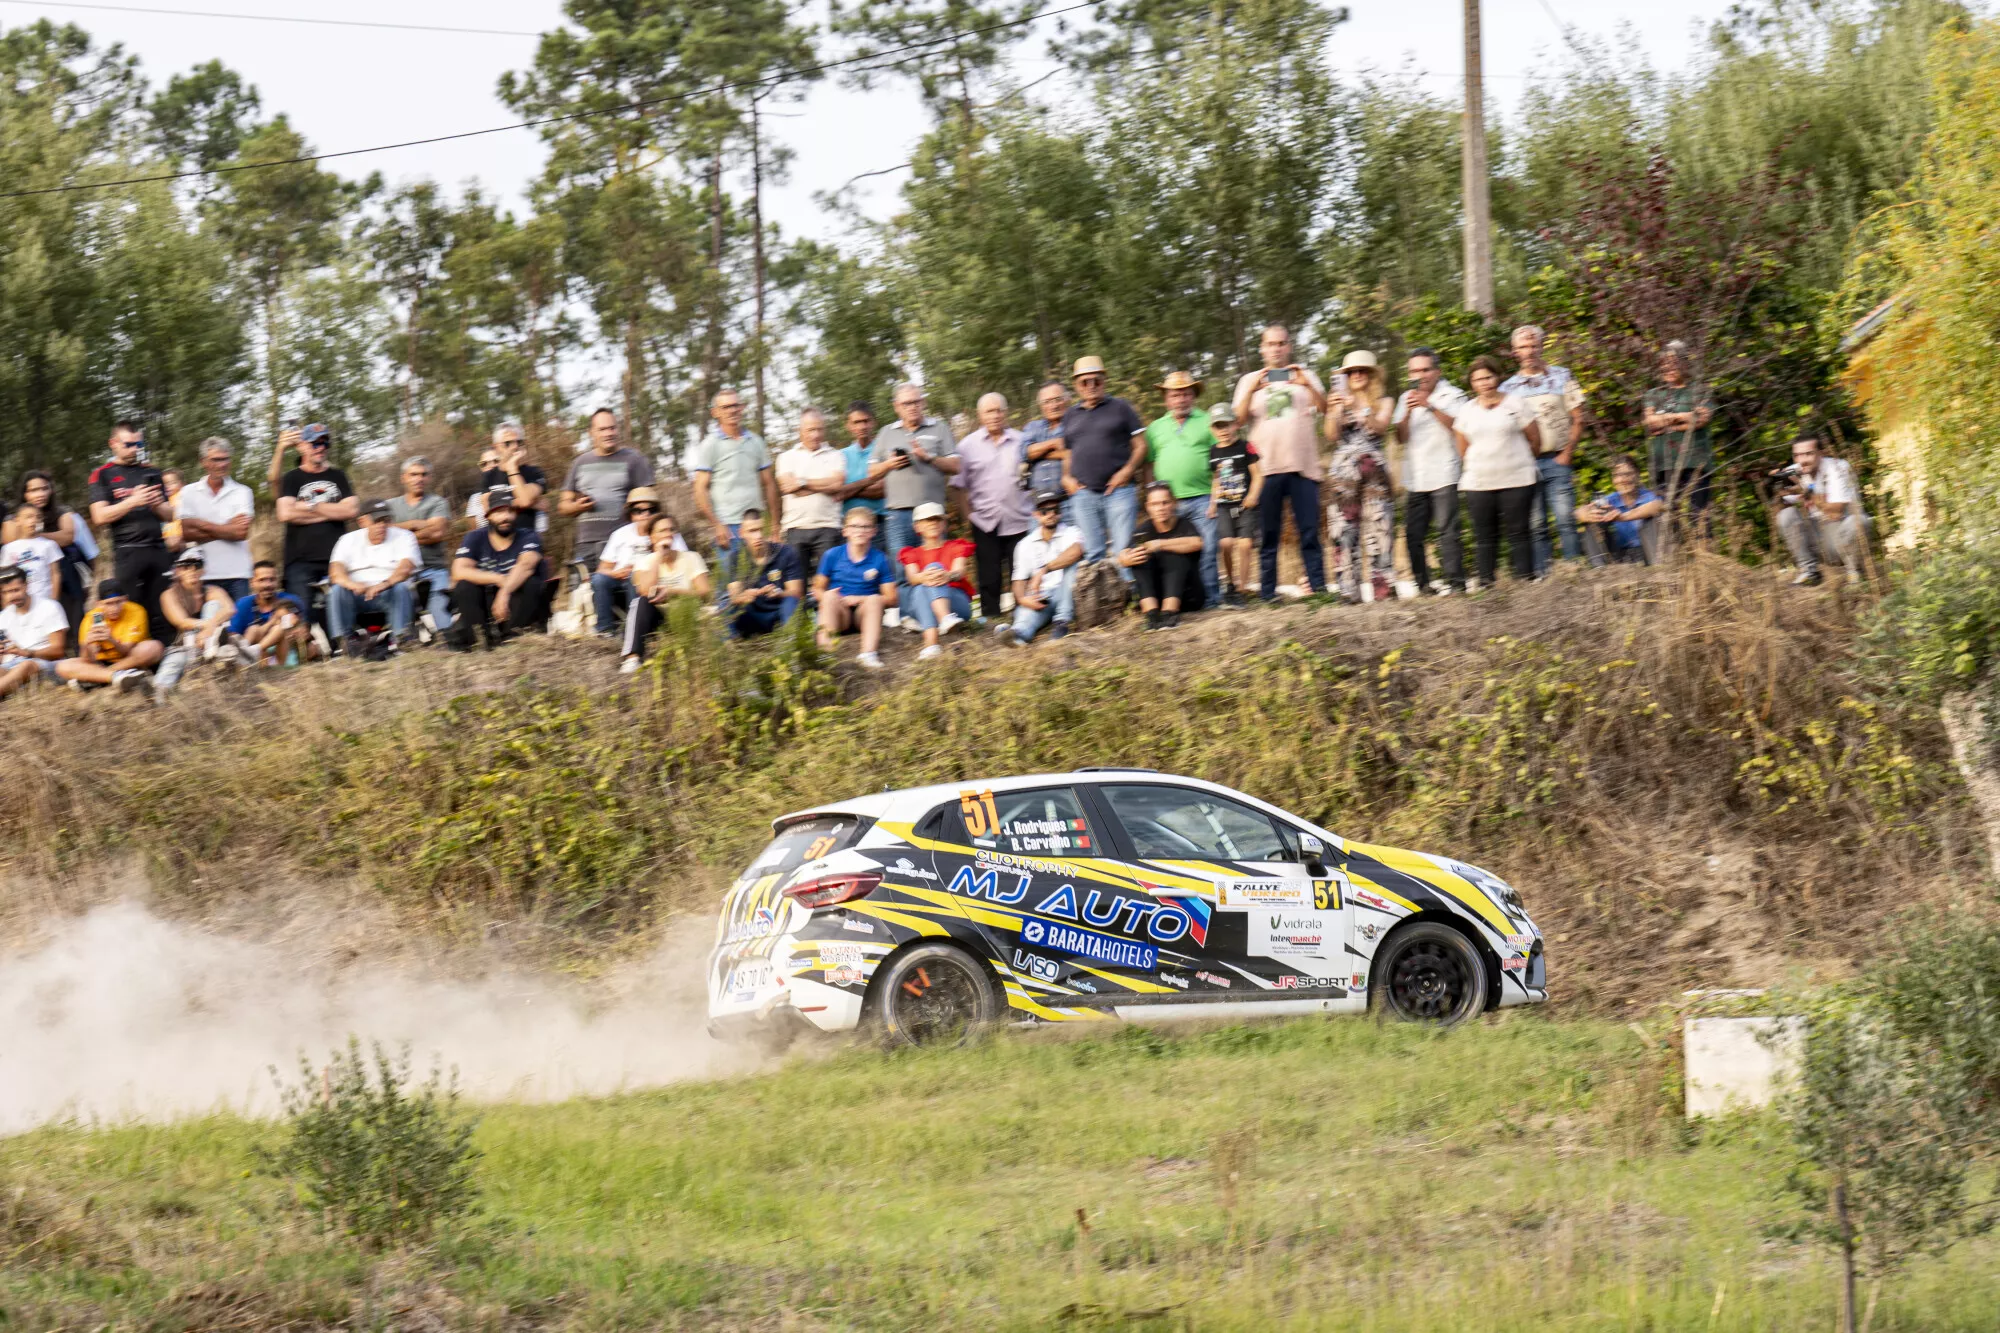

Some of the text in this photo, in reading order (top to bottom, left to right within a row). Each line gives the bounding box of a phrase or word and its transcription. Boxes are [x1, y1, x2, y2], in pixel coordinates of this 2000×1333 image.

[960, 788, 1001, 837] 51
[1003, 819, 1067, 836] J. Rodrigues
[803, 836, 837, 860] 51
[1011, 836, 1071, 852] B. Carvalho
[947, 864, 1191, 942] MJ AUTO
[1314, 880, 1340, 910] 51
[1283, 918, 1323, 930] vidrala
[1270, 934, 1322, 944] Intermarché
[821, 945, 862, 955] MOTRIO
[821, 954, 864, 963] MOBILIZE
[1013, 948, 1060, 980] LASO
